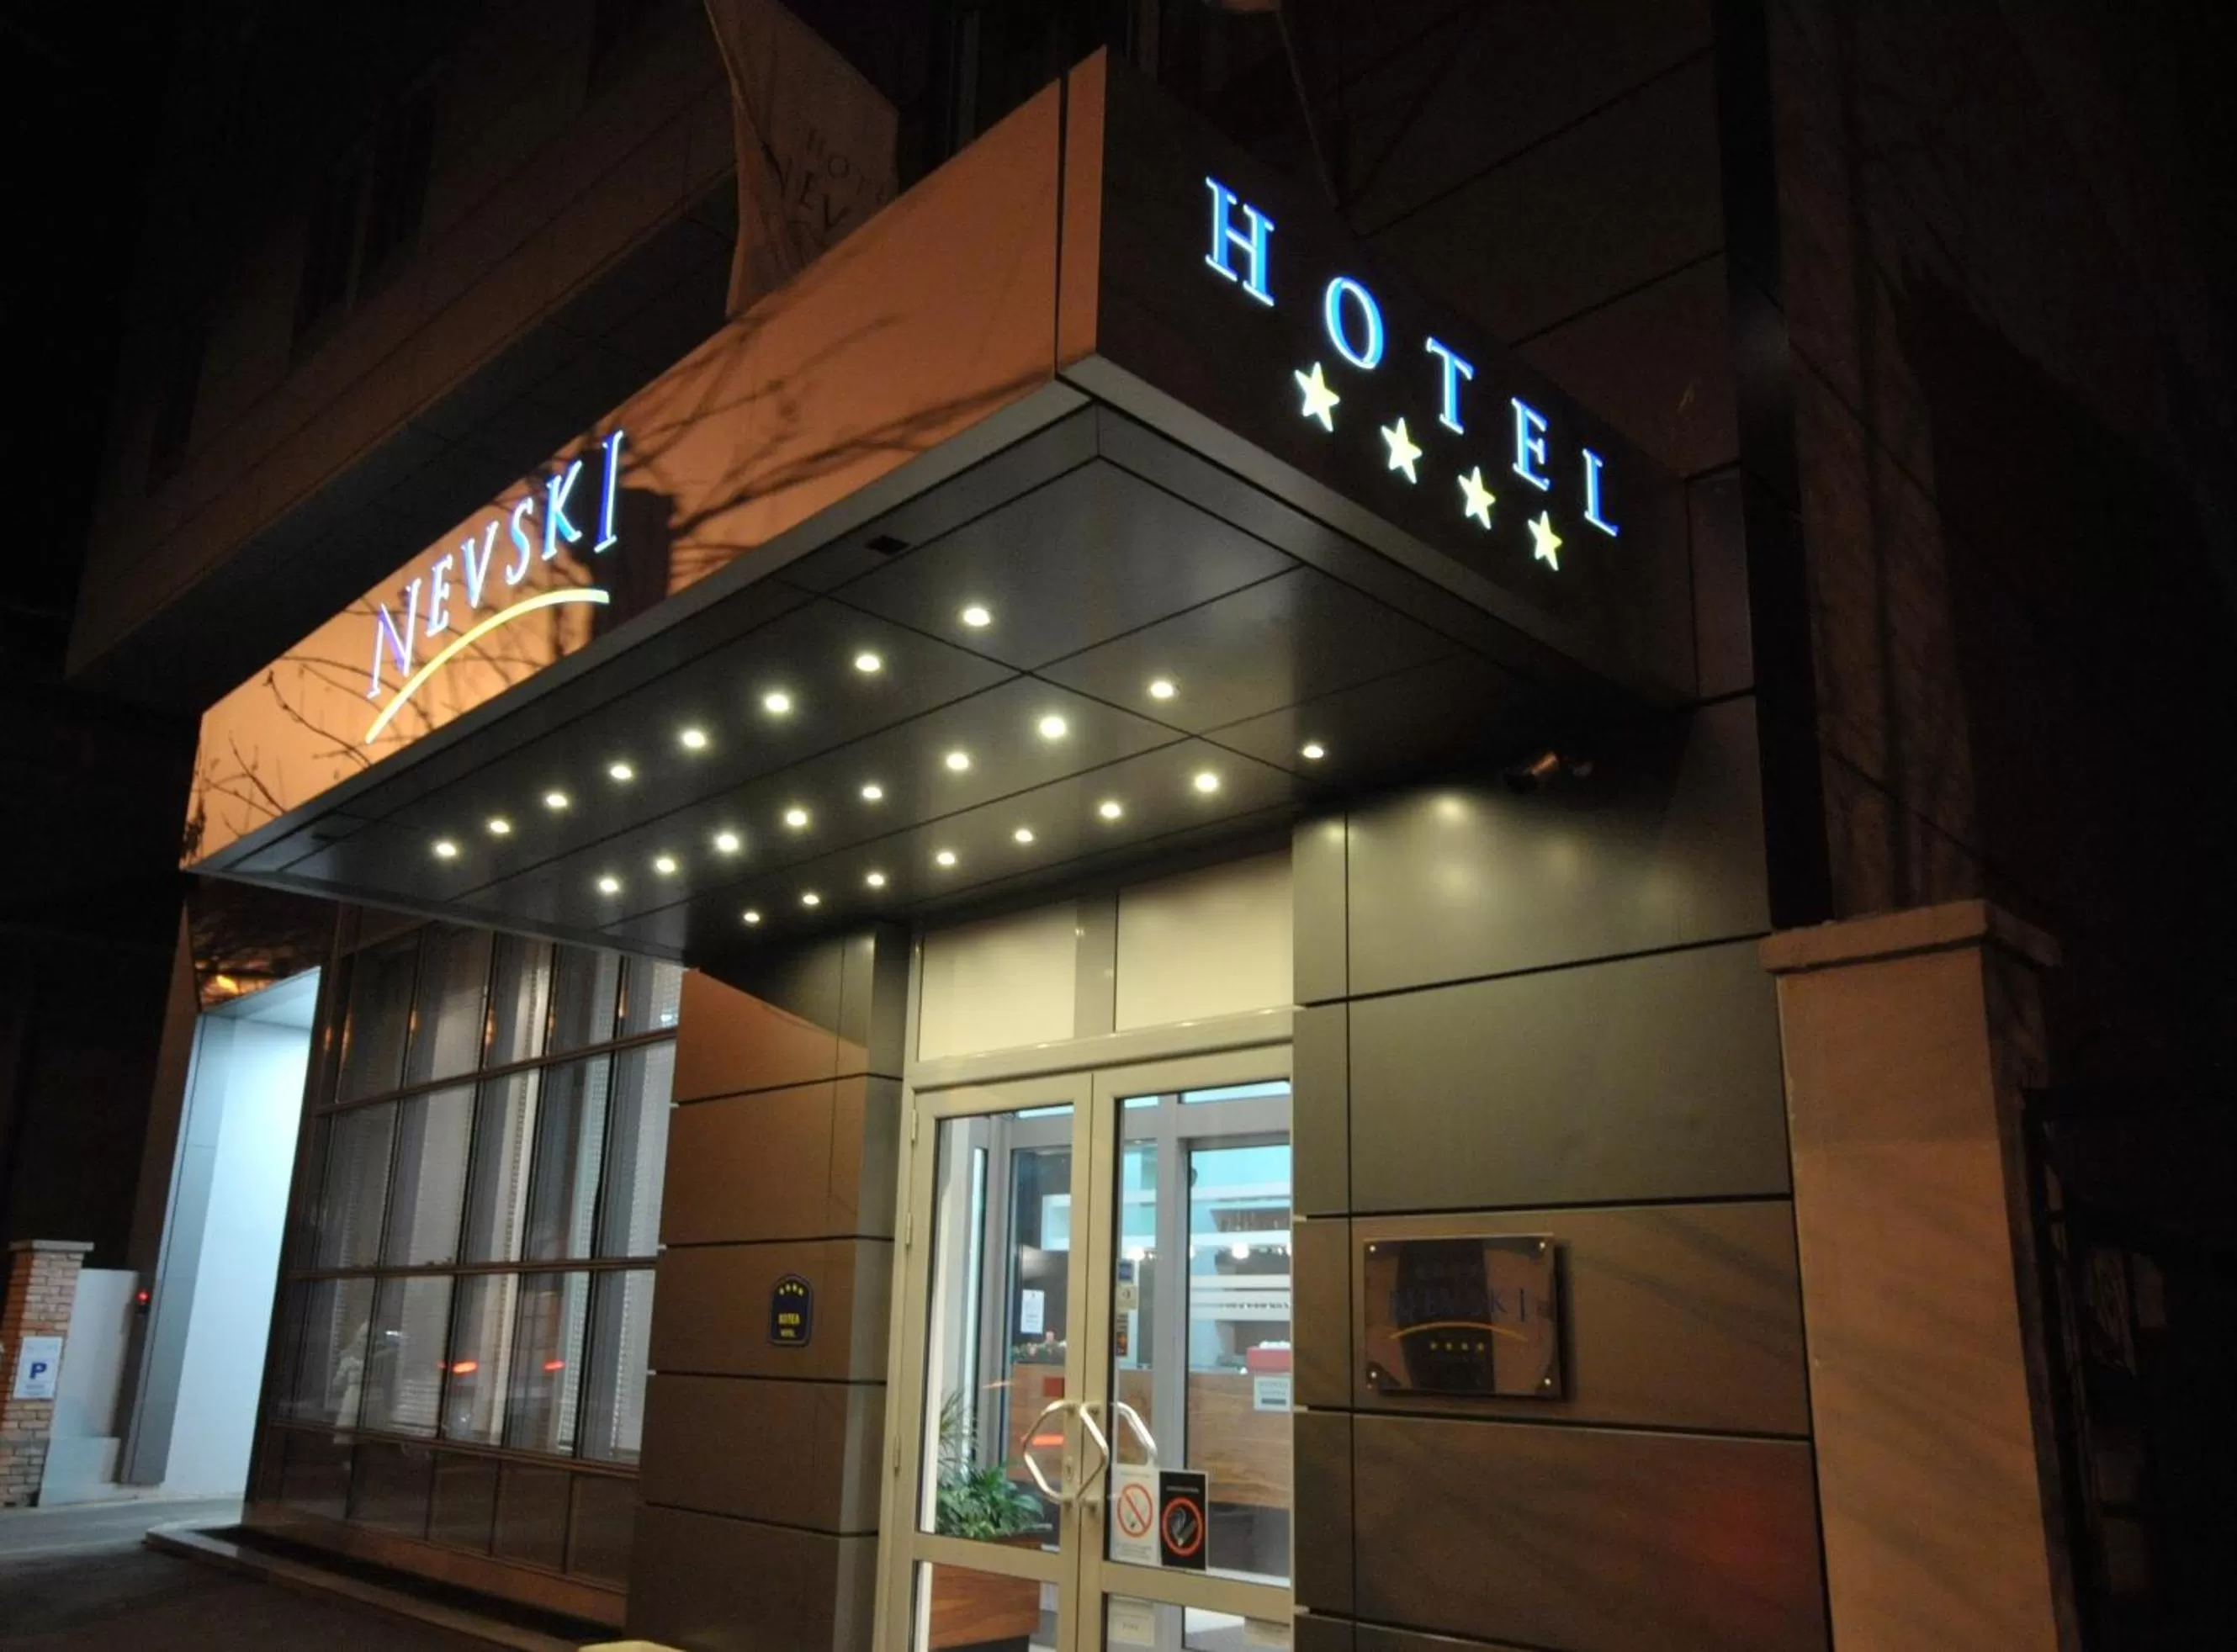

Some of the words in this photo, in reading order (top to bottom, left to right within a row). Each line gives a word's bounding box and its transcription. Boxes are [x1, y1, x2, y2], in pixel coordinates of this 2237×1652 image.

[1205, 175, 1619, 537] HOTEL
[366, 429, 625, 700] NEVSKI
[29, 1361, 48, 1379] P
